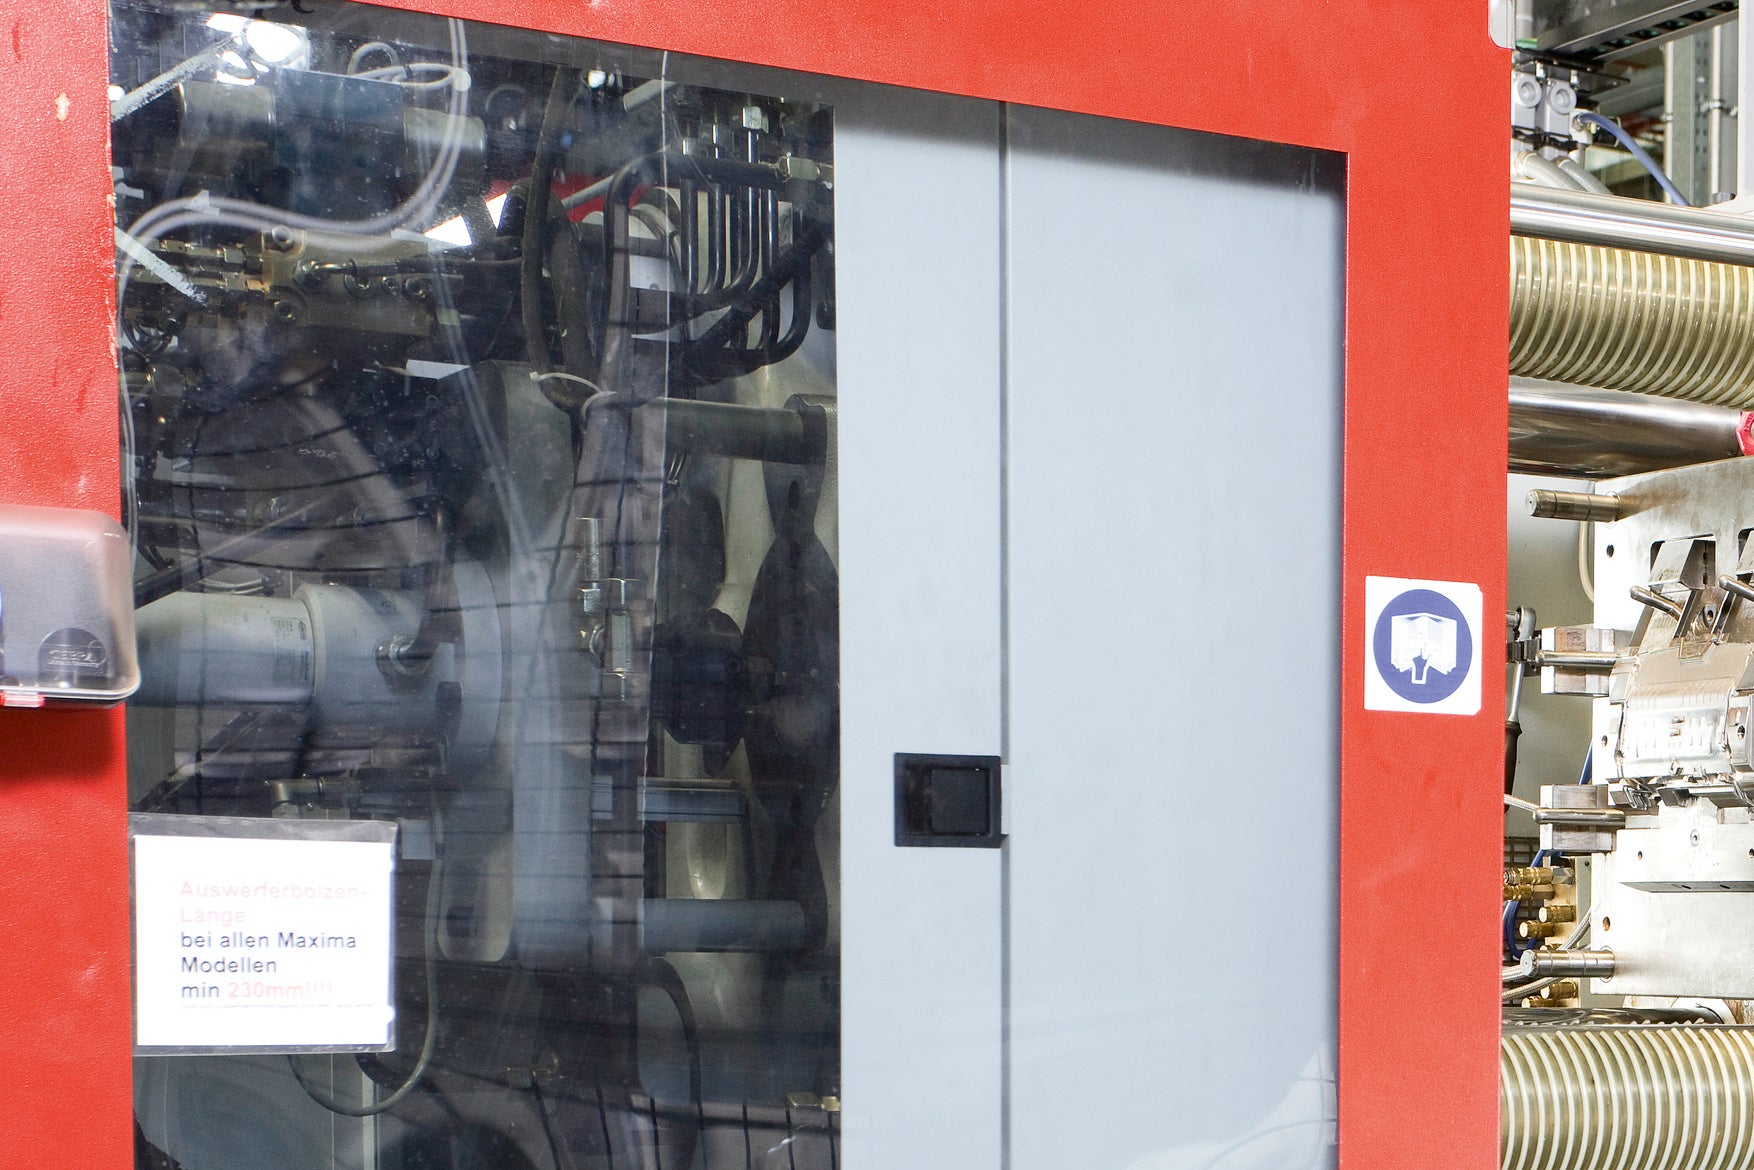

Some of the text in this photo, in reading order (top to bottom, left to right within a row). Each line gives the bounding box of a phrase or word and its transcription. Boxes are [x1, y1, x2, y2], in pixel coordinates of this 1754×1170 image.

[181, 931, 357, 949] bei allen Maxima
[181, 956, 277, 973] Modellen
[181, 982, 220, 998] min
